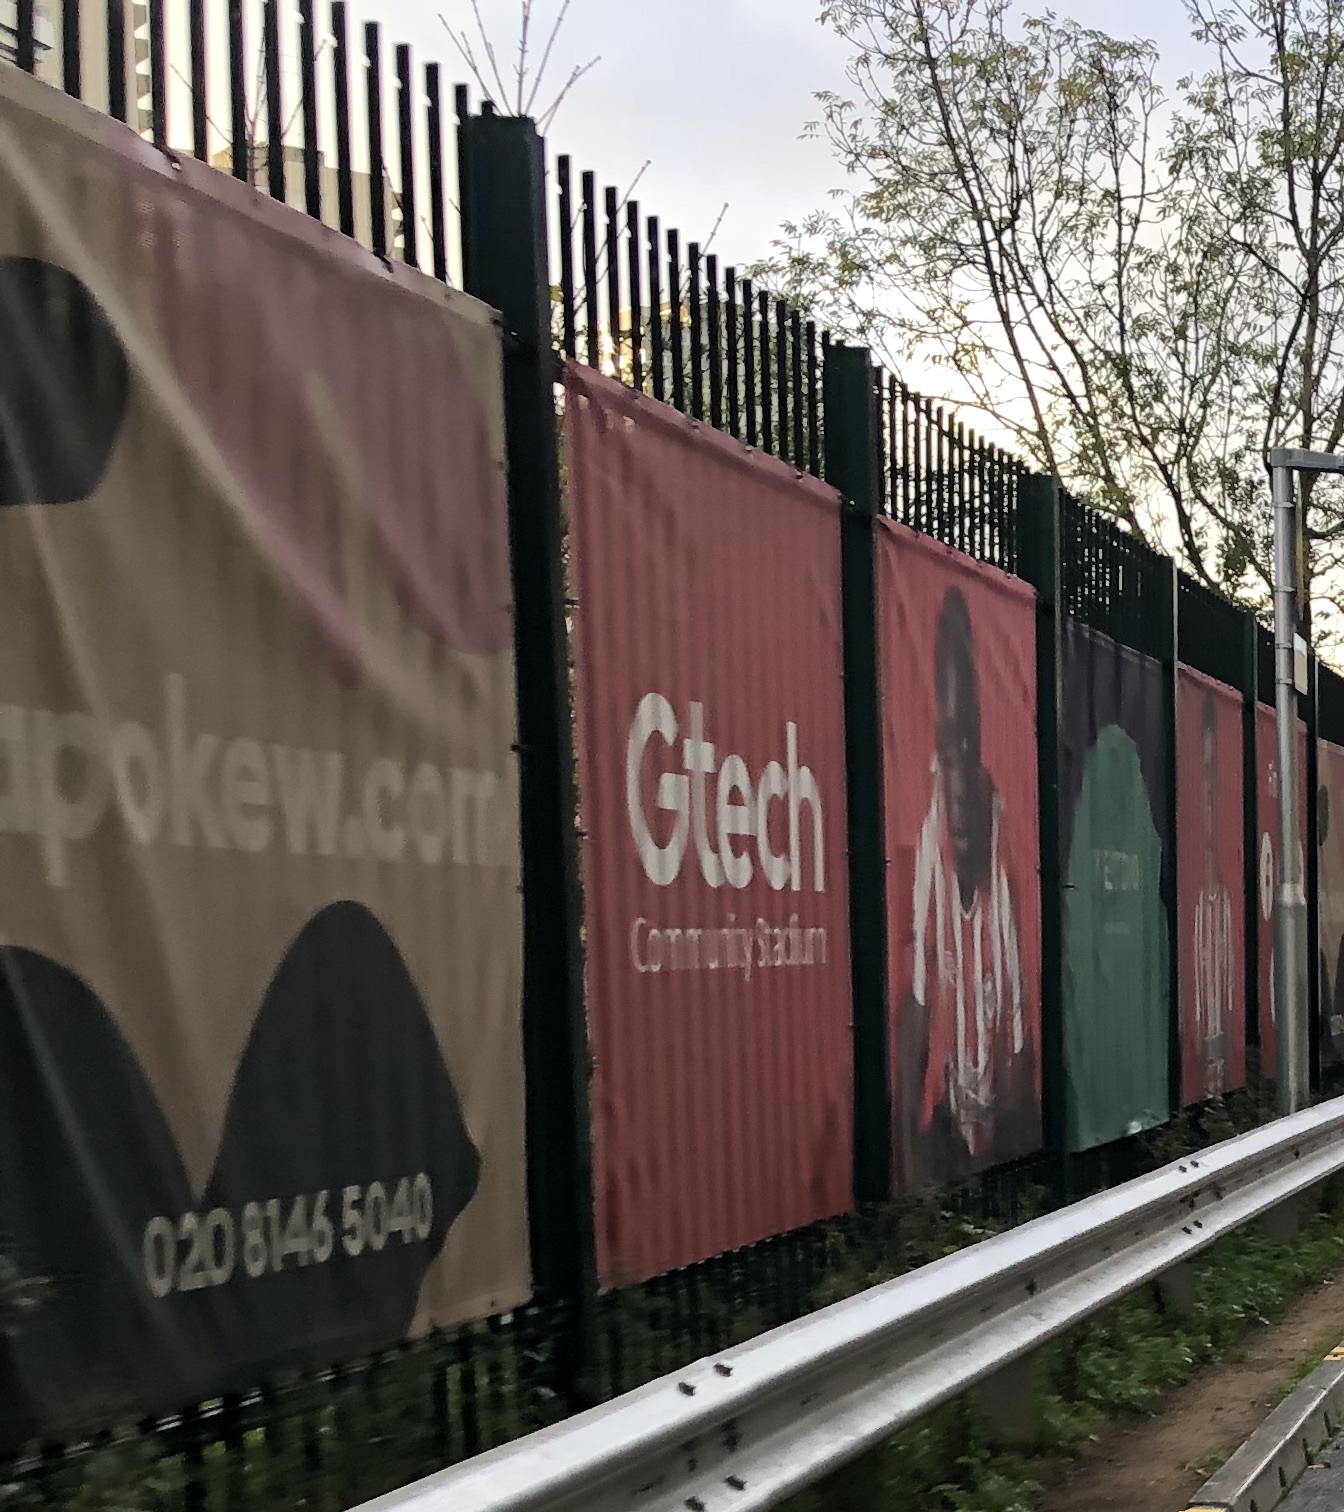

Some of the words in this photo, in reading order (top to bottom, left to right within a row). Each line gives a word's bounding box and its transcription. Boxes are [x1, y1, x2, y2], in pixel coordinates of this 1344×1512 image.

[626, 692, 825, 892] Gtech
[630, 913, 753, 982] Community
[756, 913, 827, 968] Stadium
[144, 1207, 235, 1298] 020
[243, 1189, 334, 1279] 8146
[341, 1171, 433, 1257] 5040
